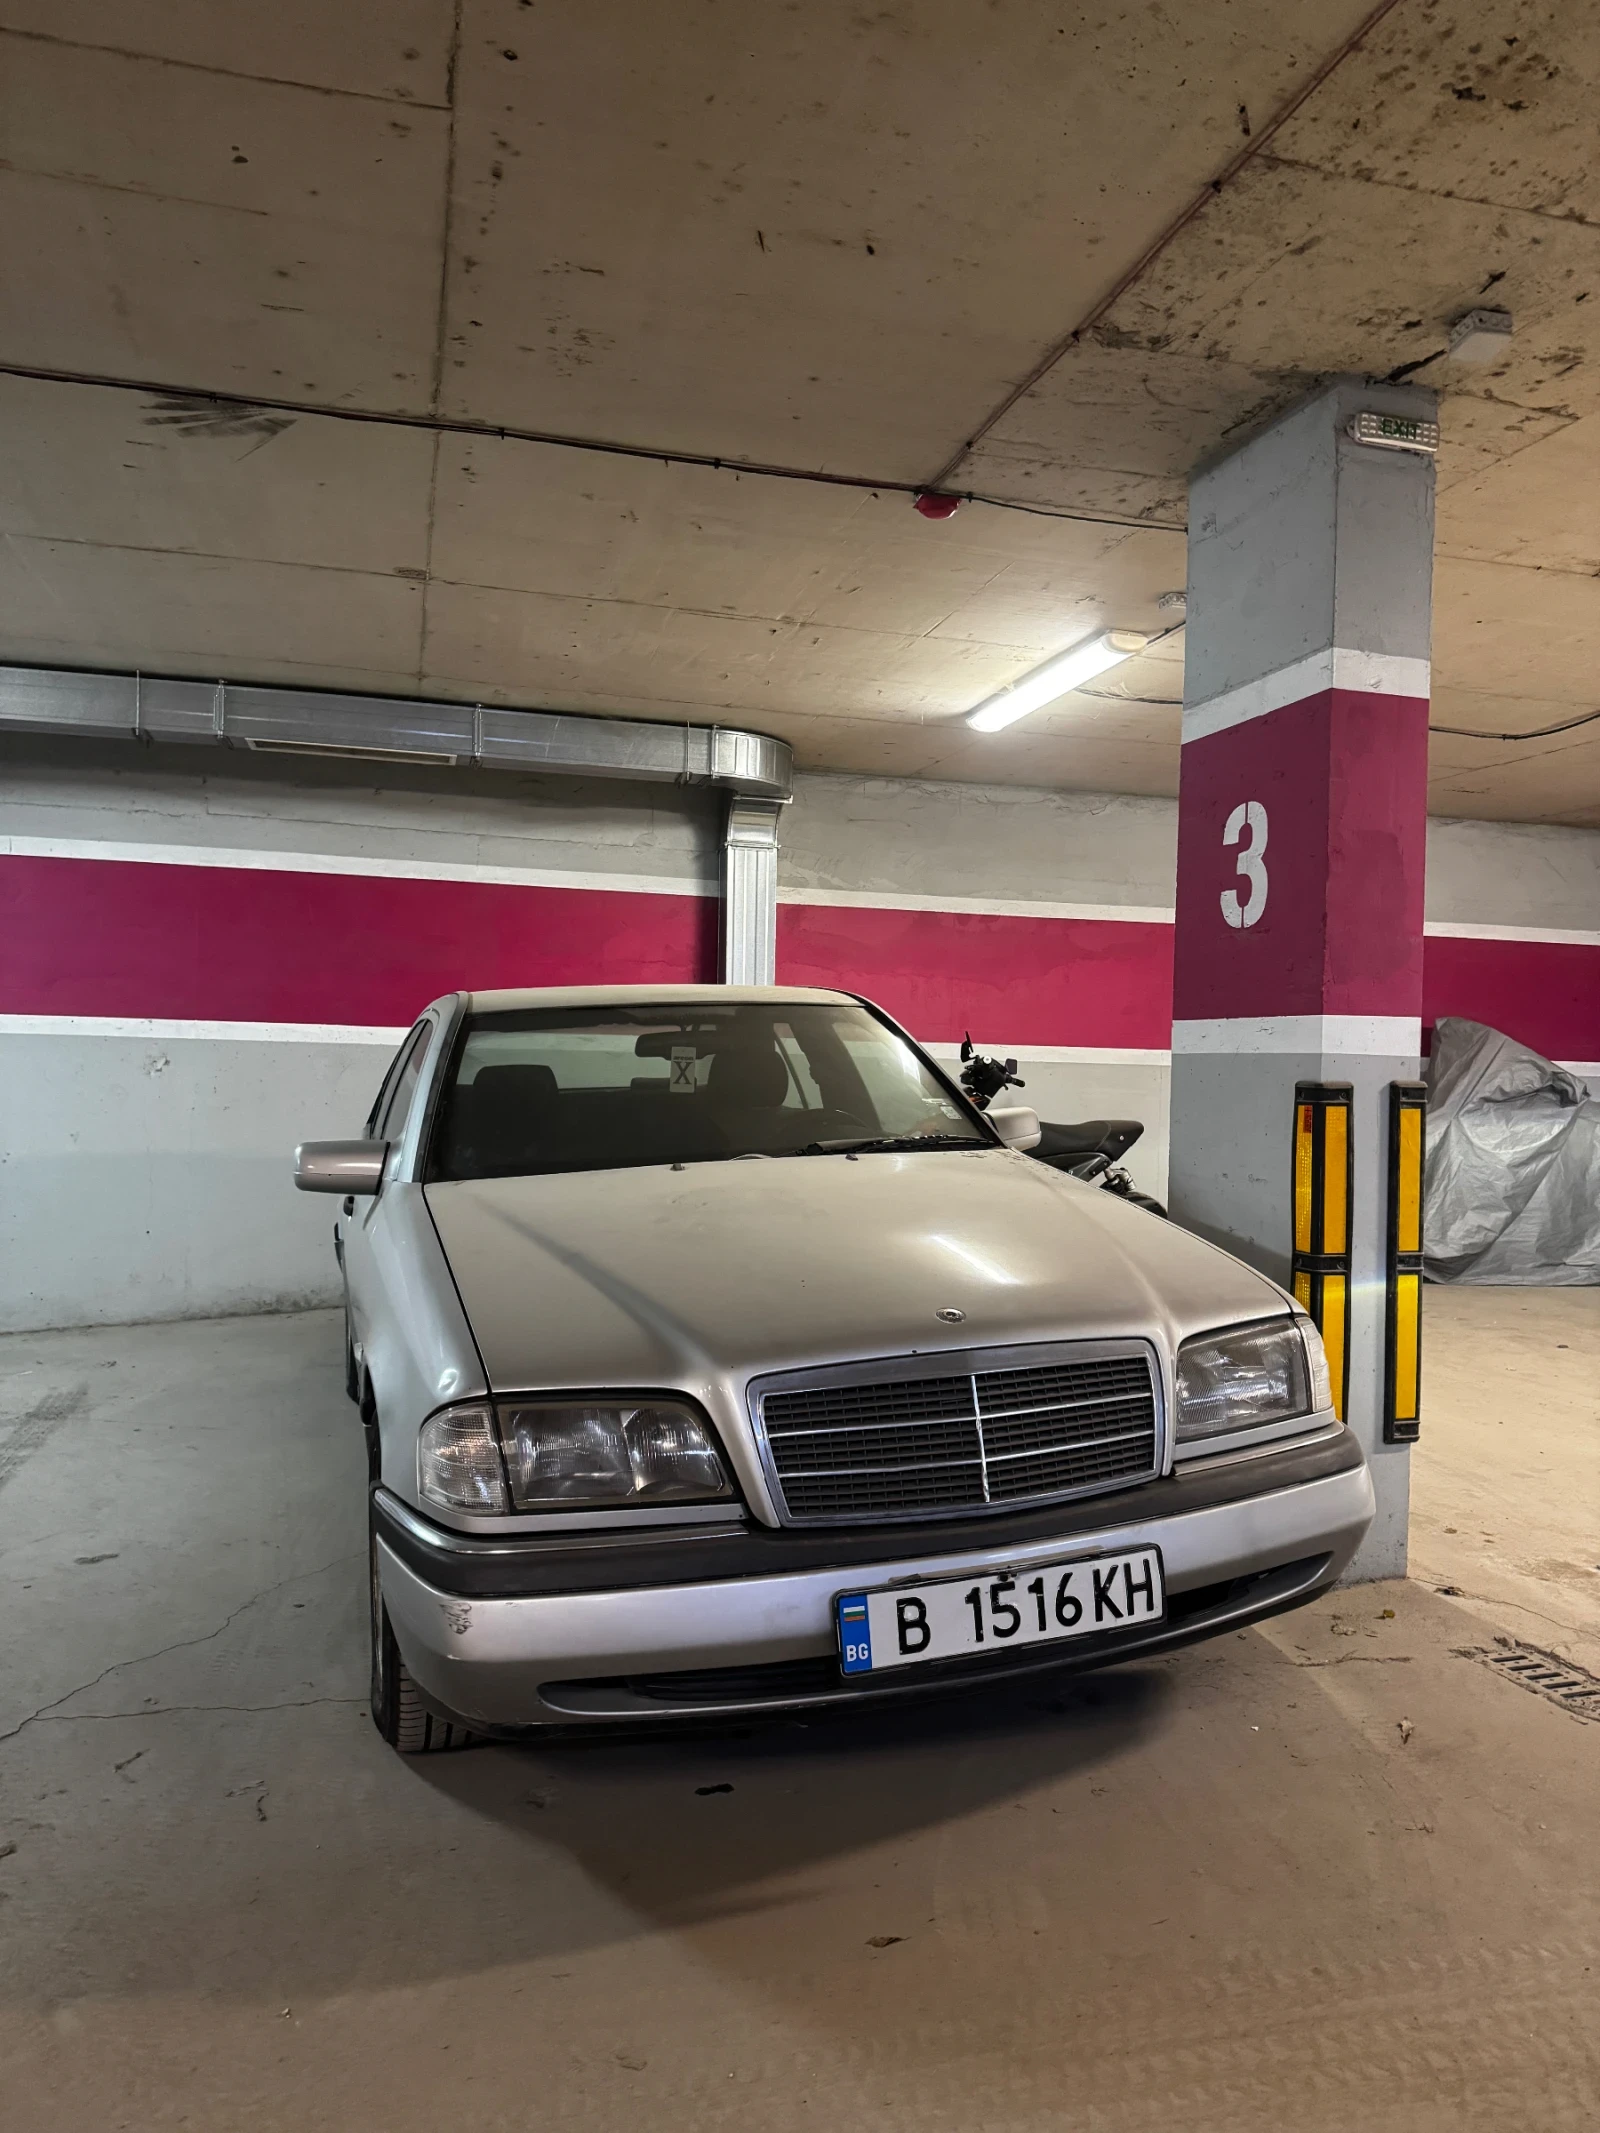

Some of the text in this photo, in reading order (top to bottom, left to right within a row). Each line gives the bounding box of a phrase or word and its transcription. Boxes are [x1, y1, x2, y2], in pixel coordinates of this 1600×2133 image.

[1381, 418, 1421, 440] EXIT
[1220, 801, 1268, 929] 3
[673, 1061, 694, 1085] X
[896, 1596, 931, 1655] B
[846, 1643, 869, 1662] BG
